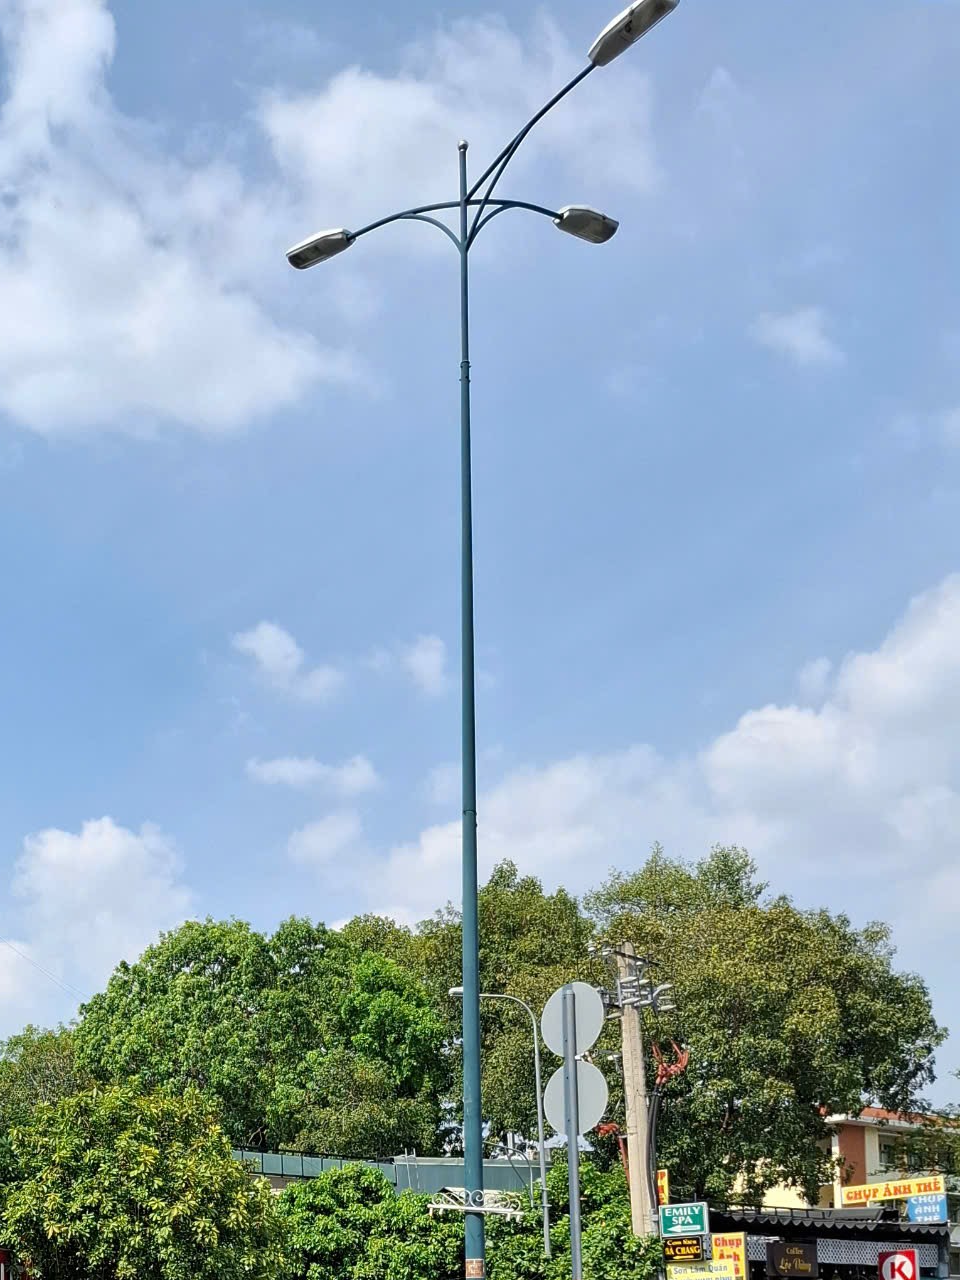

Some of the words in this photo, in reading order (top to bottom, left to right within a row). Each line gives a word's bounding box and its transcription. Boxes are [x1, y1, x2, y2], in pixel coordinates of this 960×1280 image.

[846, 1188, 878, 1201] CHỤP
[883, 1183, 912, 1197] ẢNH
[916, 1178, 941, 1192] THẺ
[665, 1207, 700, 1217] EMILY
[672, 1216, 693, 1225] SPA
[714, 1237, 742, 1249] Chụp
[675, 1245, 700, 1255] CHANG
